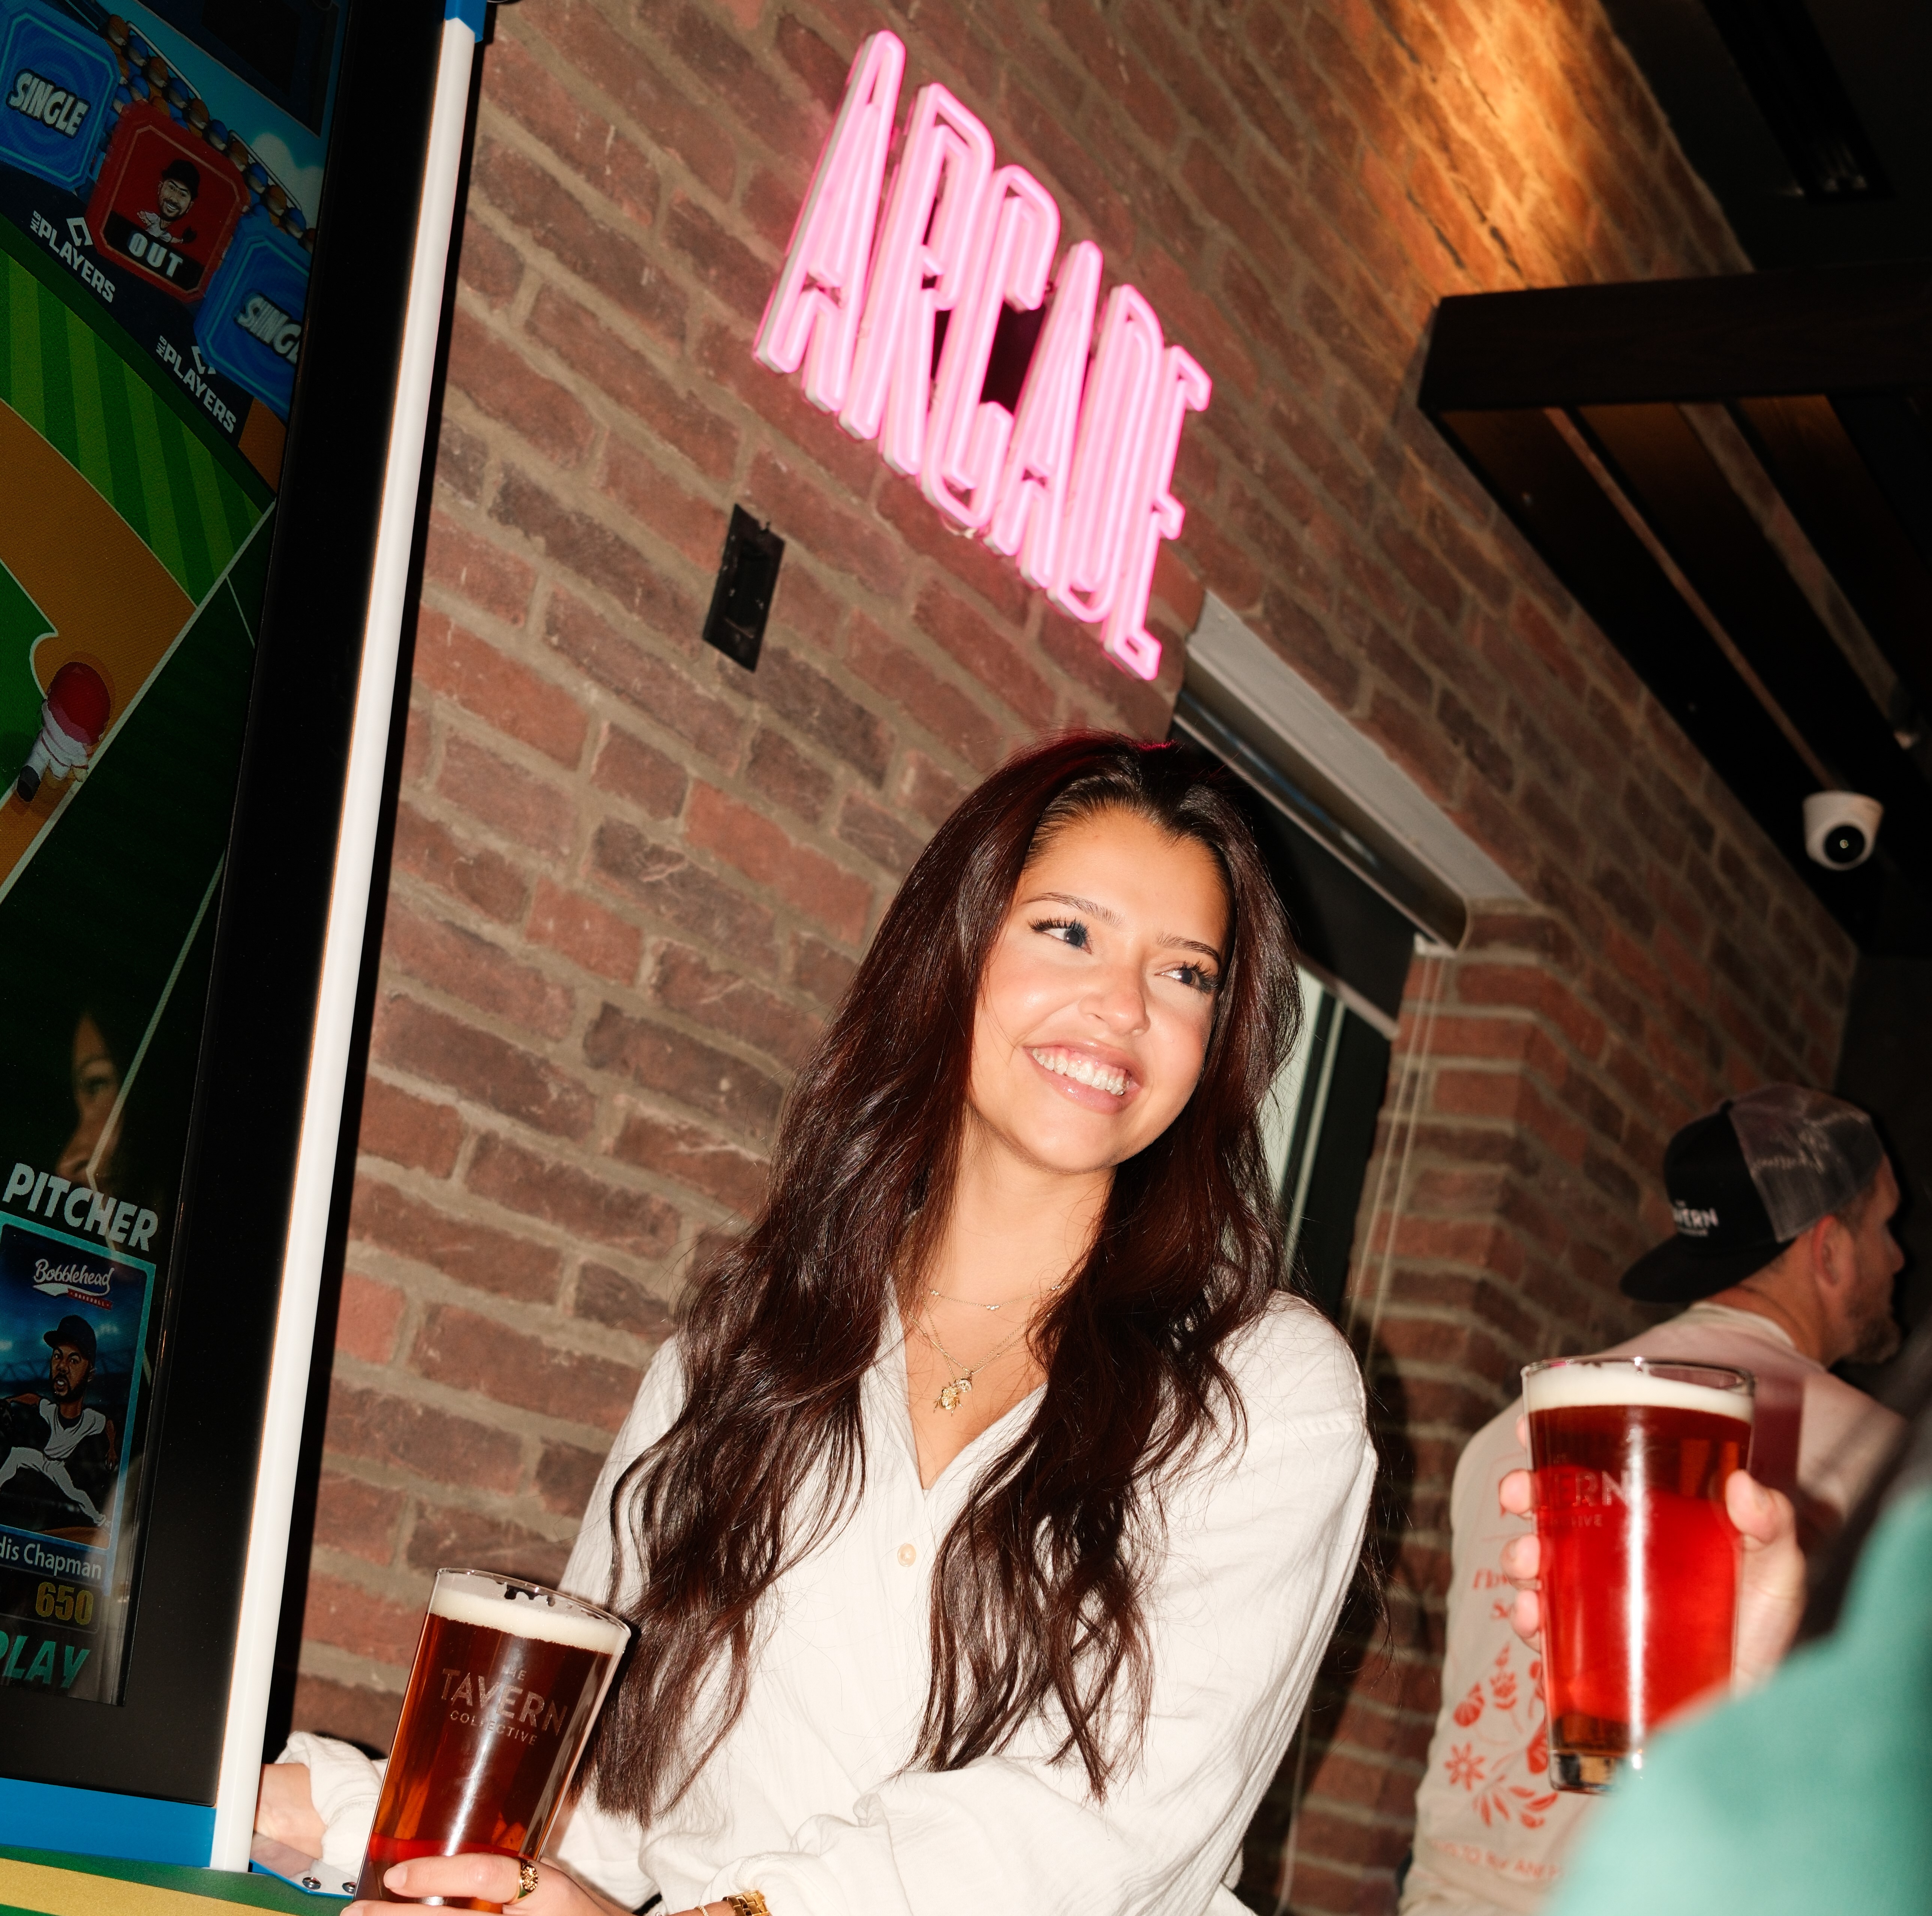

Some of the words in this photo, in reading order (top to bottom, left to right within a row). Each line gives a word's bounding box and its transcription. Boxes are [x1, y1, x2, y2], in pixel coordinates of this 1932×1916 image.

[9, 73, 89, 136] SINGLE
[30, 210, 41, 233] MLB
[38, 217, 116, 303] PLAYERS
[129, 233, 183, 278] OUT
[156, 335, 167, 358] MLB
[756, 31, 1212, 680] ARCADE
[163, 343, 236, 434] PLAYERS
[2, 1162, 159, 1251] PITCHER
[33, 1258, 115, 1287] Bobblehead
[24, 1543, 102, 1579] Chapman
[35, 1581, 94, 1625] 650
[441, 1668, 568, 1736] TAVERN
